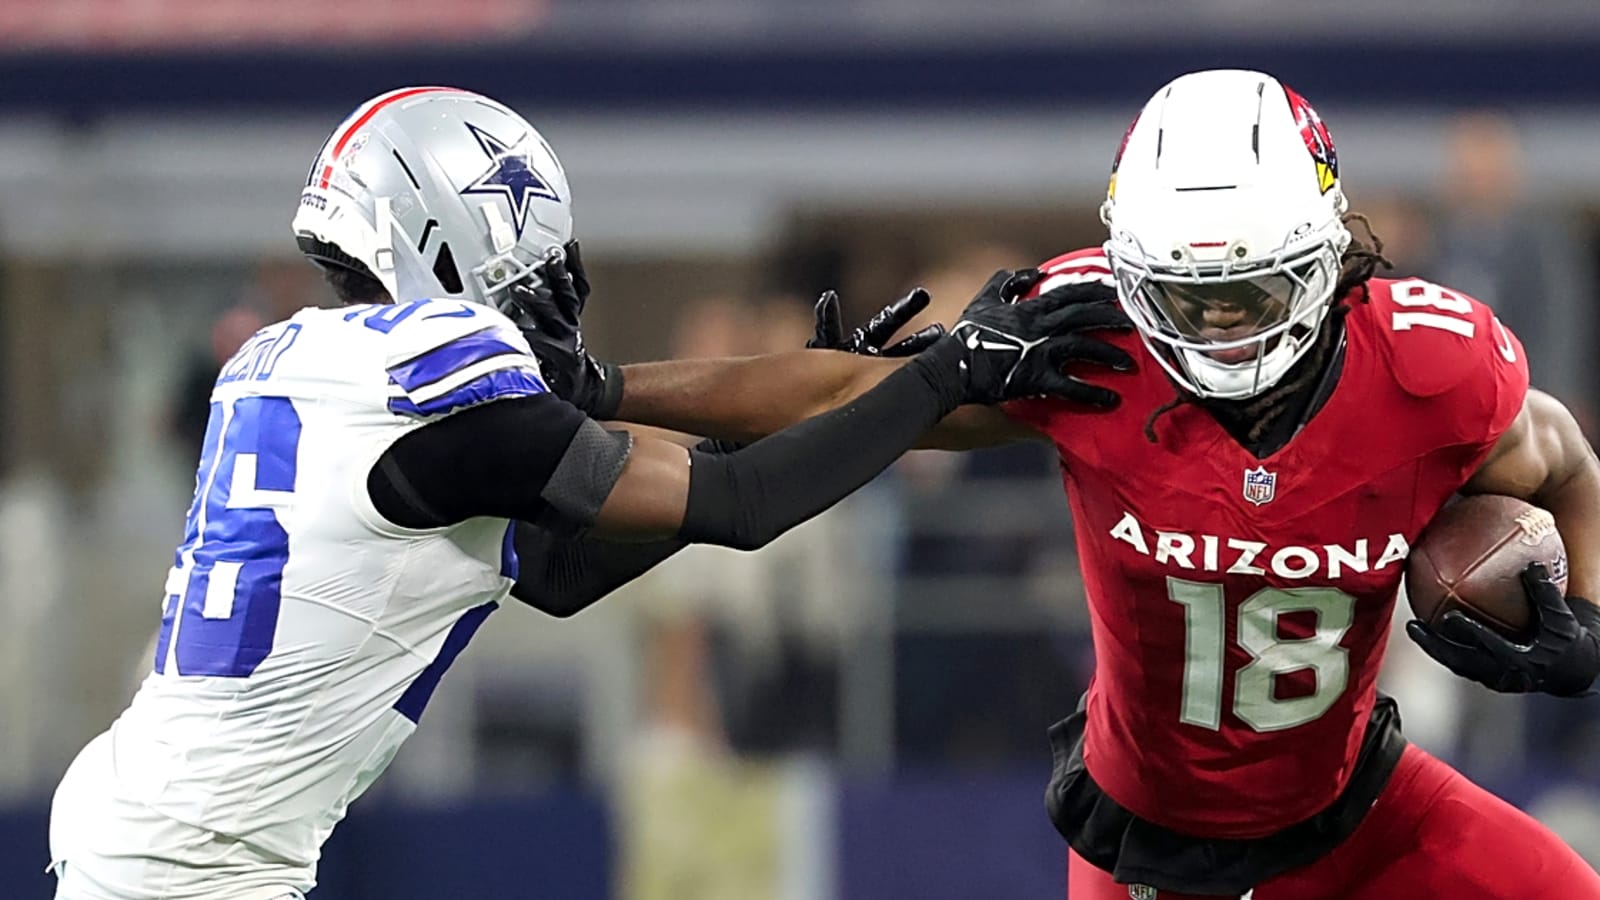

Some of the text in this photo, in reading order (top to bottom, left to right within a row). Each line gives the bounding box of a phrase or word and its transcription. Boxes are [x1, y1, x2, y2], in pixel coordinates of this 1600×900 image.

[1390, 279, 1475, 339] 18
[1110, 511, 1409, 579] ARIZONA
[1166, 576, 1357, 733] 18
